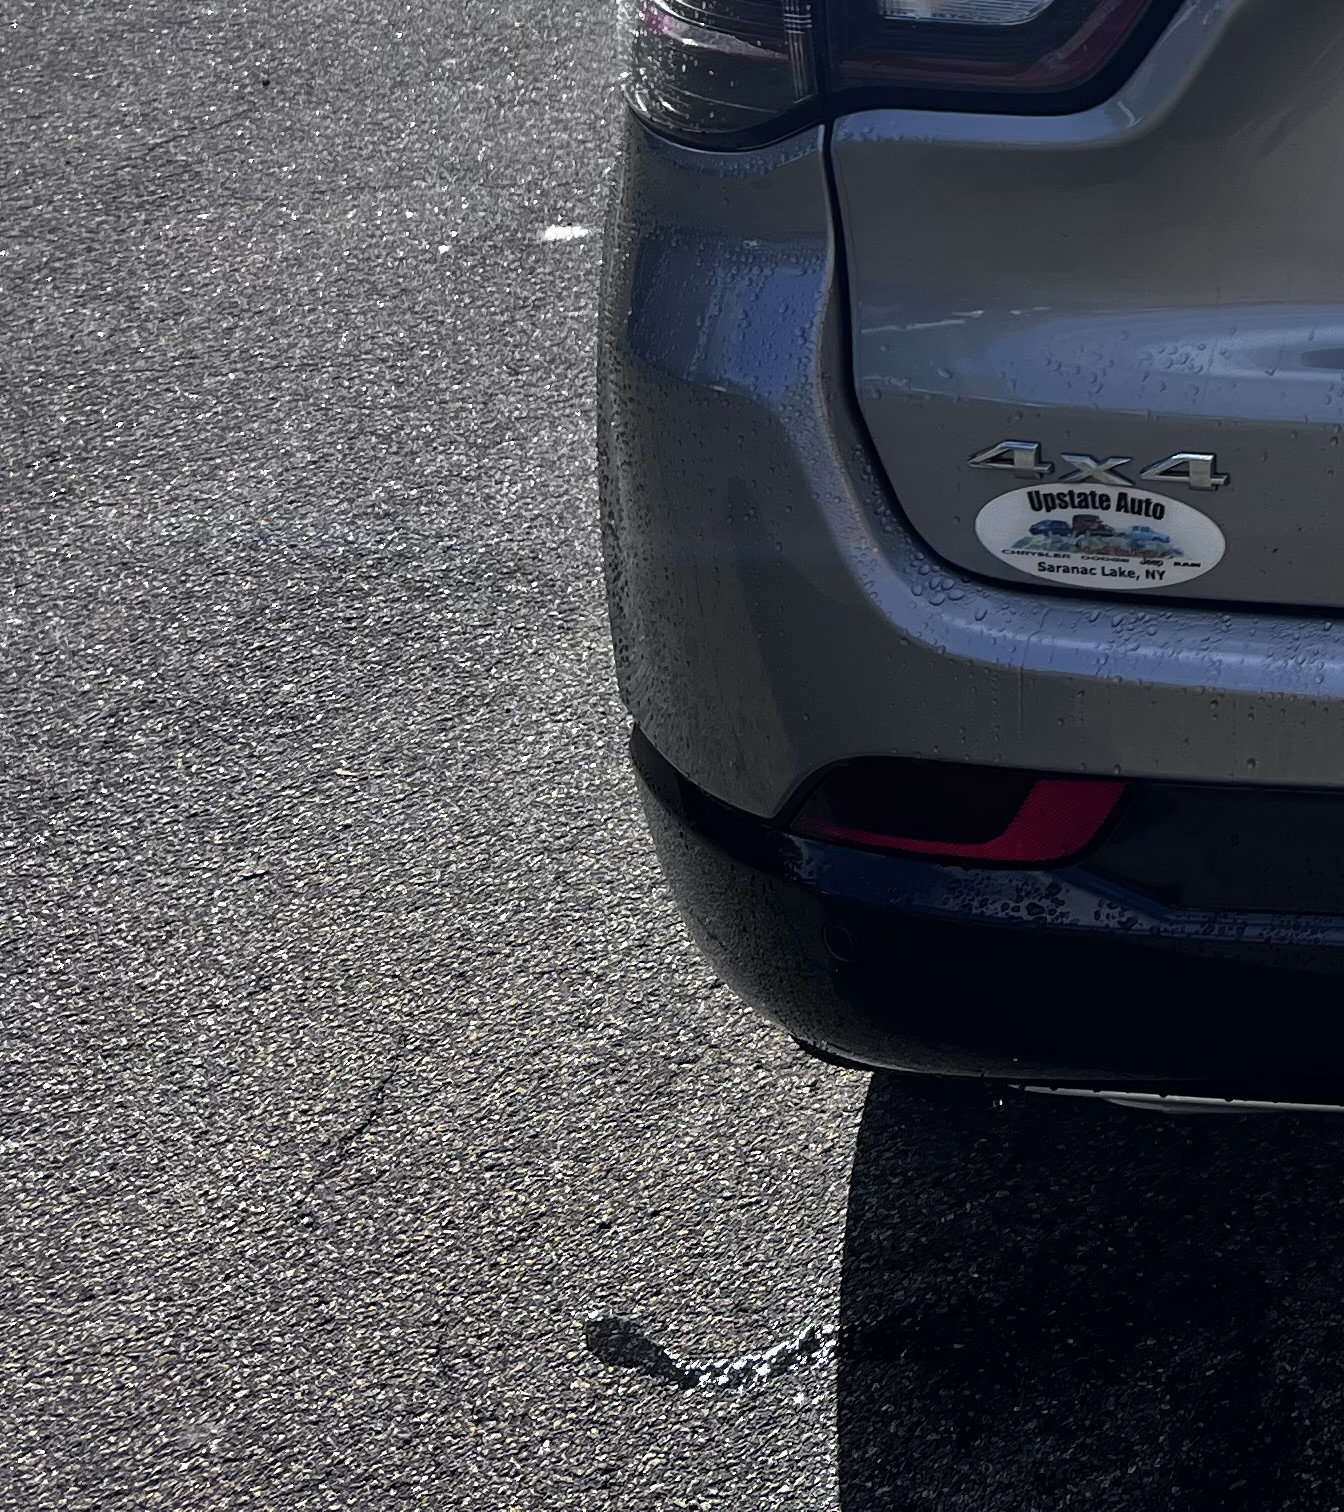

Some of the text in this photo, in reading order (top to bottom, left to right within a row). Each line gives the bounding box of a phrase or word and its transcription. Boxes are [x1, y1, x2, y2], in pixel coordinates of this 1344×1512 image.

[1027, 489, 1166, 520] Upstate Auto
[1037, 562, 1166, 581] Saranac Lake, NY
